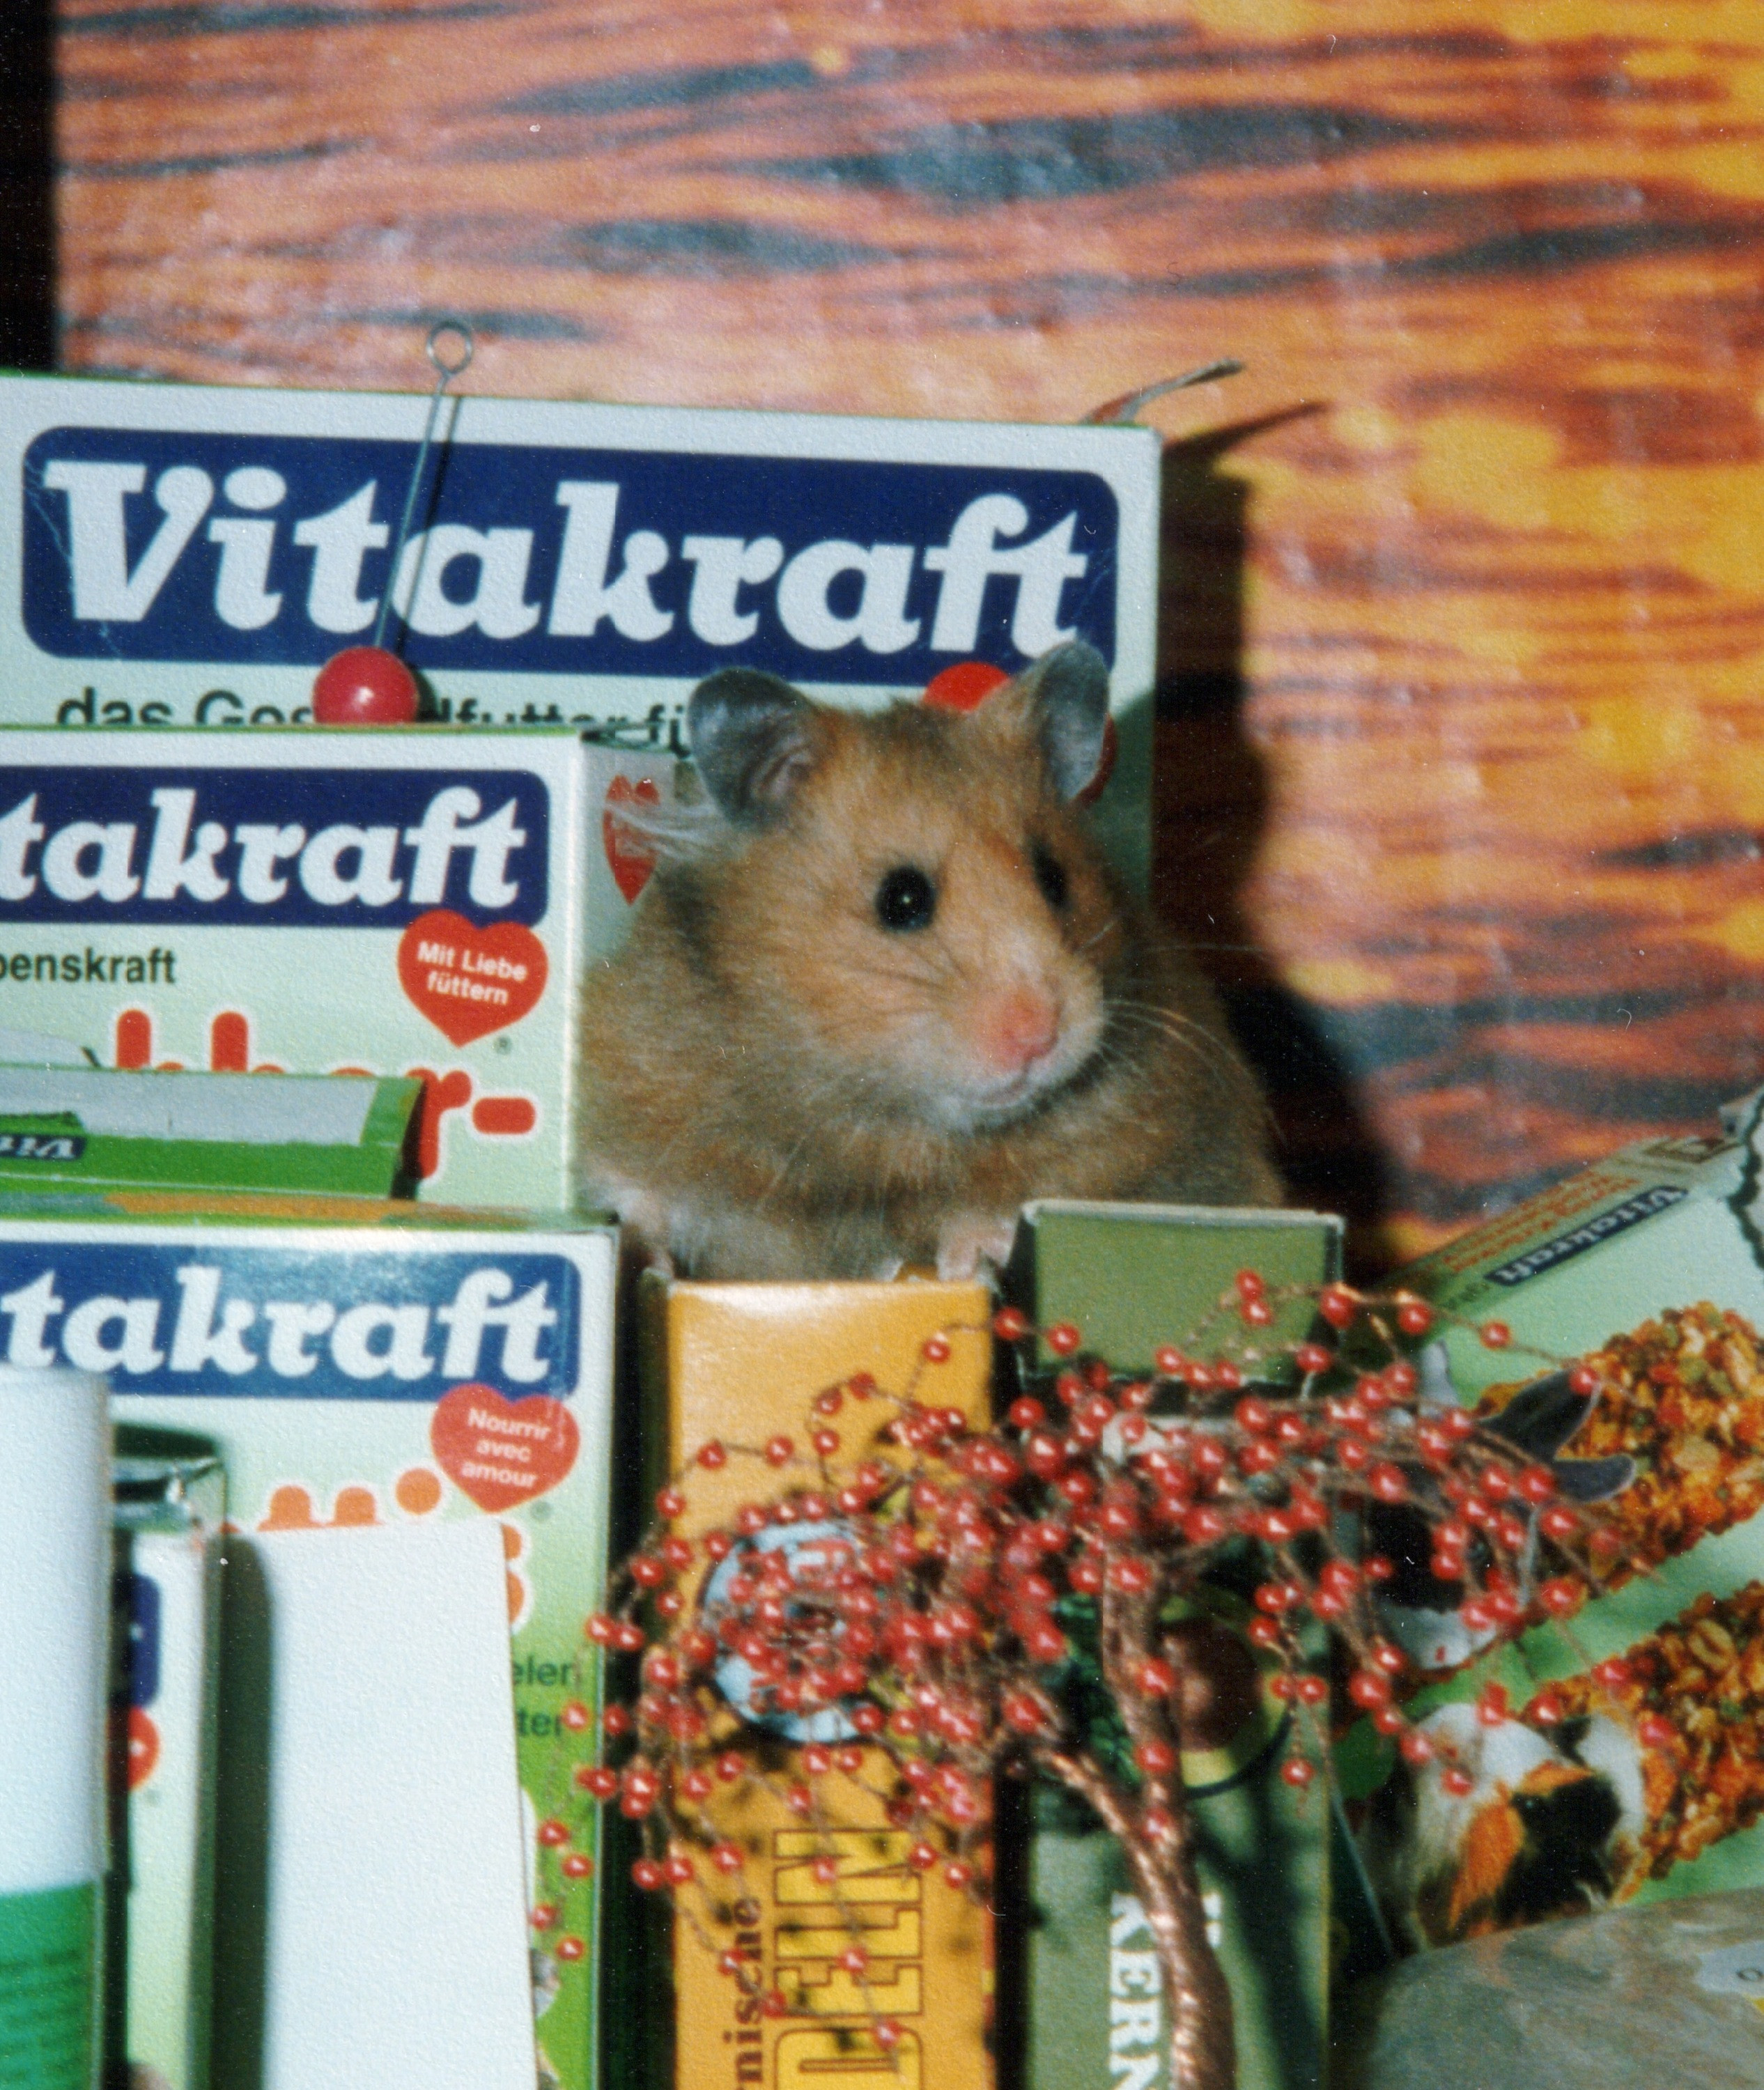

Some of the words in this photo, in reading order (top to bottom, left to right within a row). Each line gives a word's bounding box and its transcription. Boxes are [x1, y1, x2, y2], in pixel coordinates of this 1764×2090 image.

[43, 460, 1089, 659] Vitakraft
[417, 940, 455, 968] Mit
[461, 949, 527, 983] Liebe
[427, 970, 509, 1005] füttern
[0, 1264, 557, 1384] takraft
[467, 1407, 551, 1441] Nourrir
[476, 1439, 532, 1463] avec
[461, 1462, 538, 1489] amour
